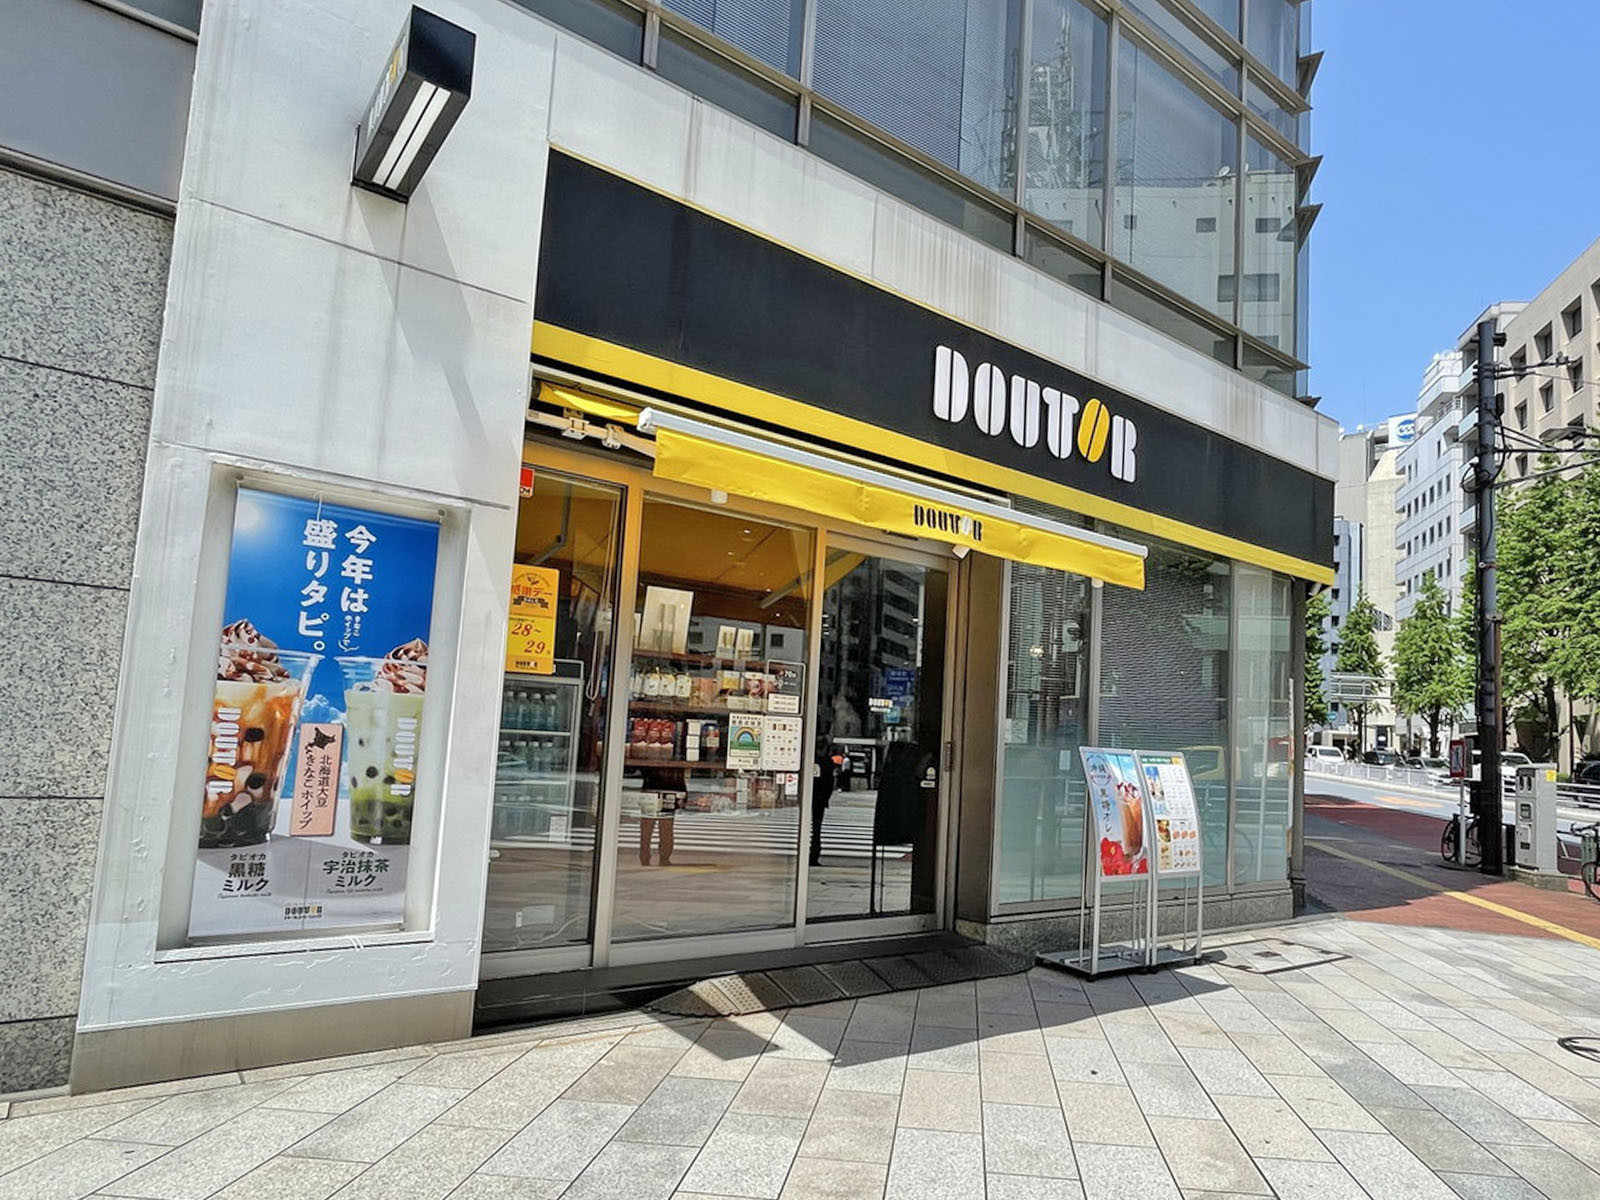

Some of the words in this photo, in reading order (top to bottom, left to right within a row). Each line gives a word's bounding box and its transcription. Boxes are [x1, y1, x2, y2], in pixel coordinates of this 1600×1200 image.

[932, 345, 1138, 484] DOUTOR
[913, 505, 983, 542] DOUTOR
[341, 525, 376, 613] 今年は
[297, 519, 337, 651] 盛りタピ。
[524, 639, 546, 655] 29
[316, 754, 332, 808] 北海道大豆
[228, 862, 266, 878] 黒糖
[322, 858, 390, 875] 宇治抹茶
[222, 877, 269, 893] ミルク
[335, 874, 377, 888] ミルク
